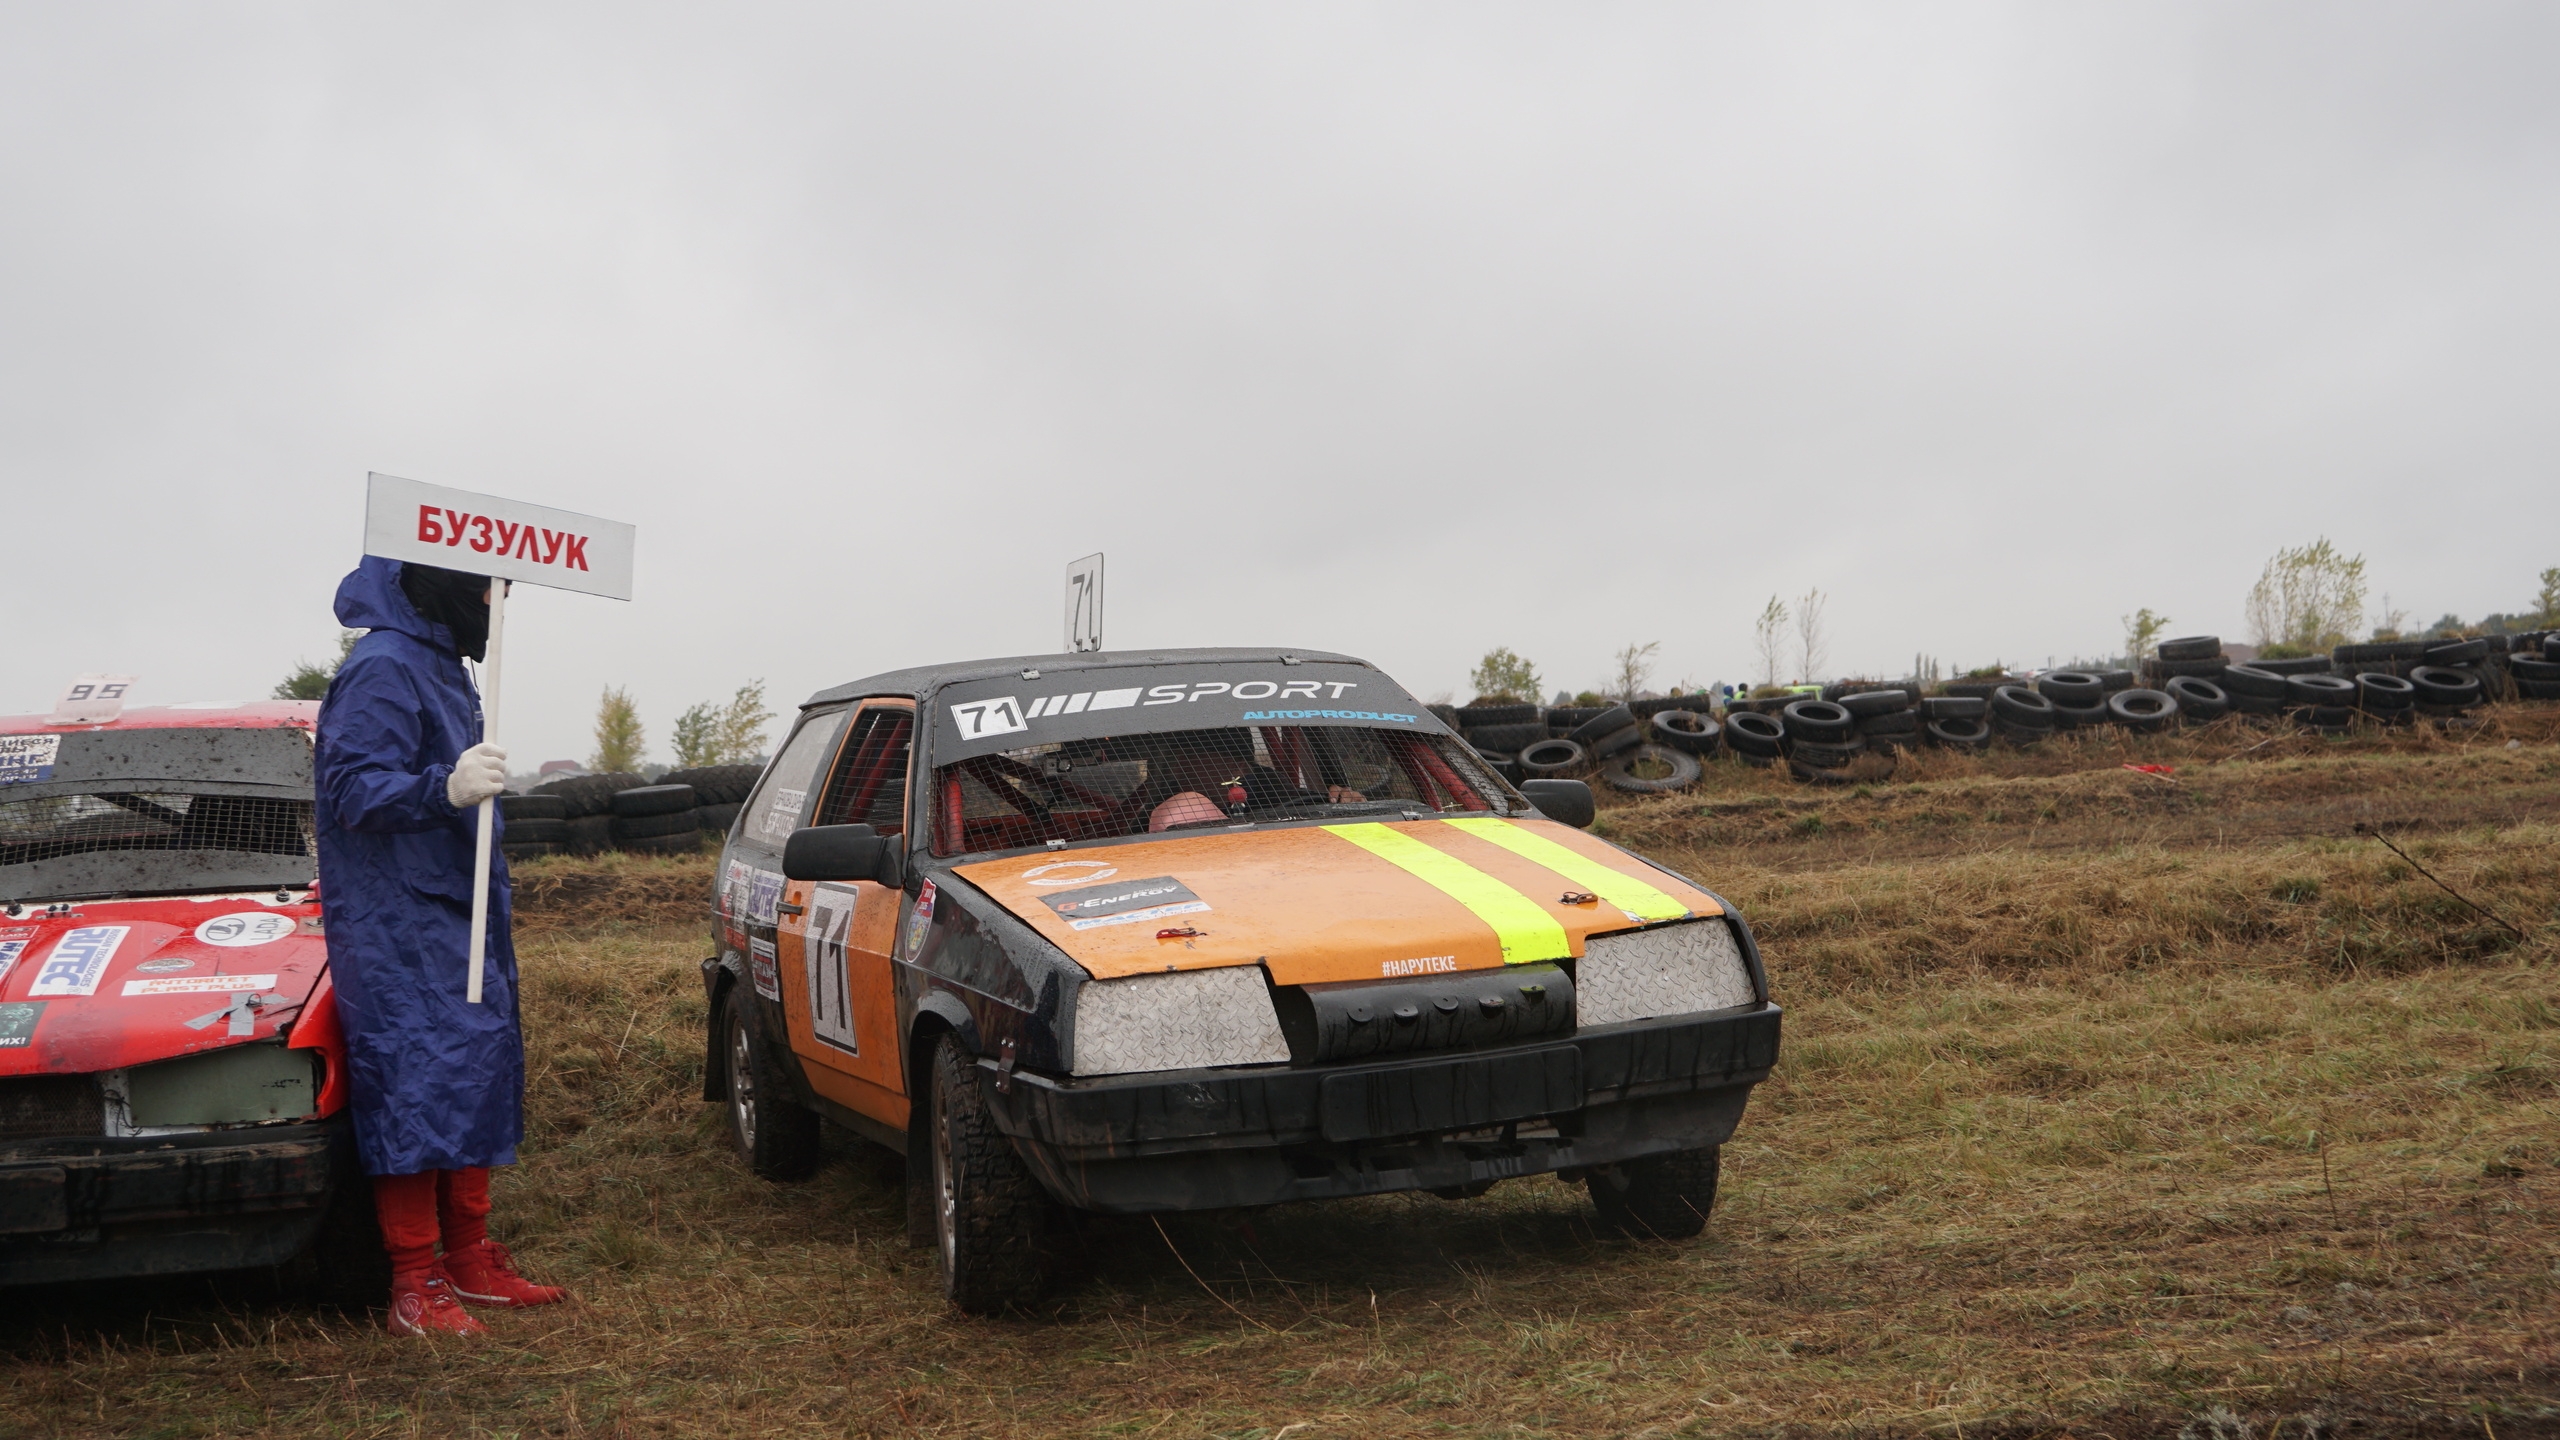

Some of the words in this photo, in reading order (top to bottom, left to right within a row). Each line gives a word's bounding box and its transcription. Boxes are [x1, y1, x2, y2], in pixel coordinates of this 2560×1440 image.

[417, 504, 589, 572] БУЗУЛУК
[1072, 569, 1094, 644] 71
[66, 683, 128, 701] 95
[1143, 680, 1358, 706] SPORT
[960, 701, 1020, 734] 71
[1243, 708, 1418, 724] AUTOPRODUCT
[249, 917, 283, 940] LADA
[40, 928, 111, 987] RUTEC
[80, 948, 110, 987] TECHNOLOGIES
[812, 904, 852, 1031] 71
[140, 984, 199, 993] PLAST
[208, 982, 256, 991] PLUS
